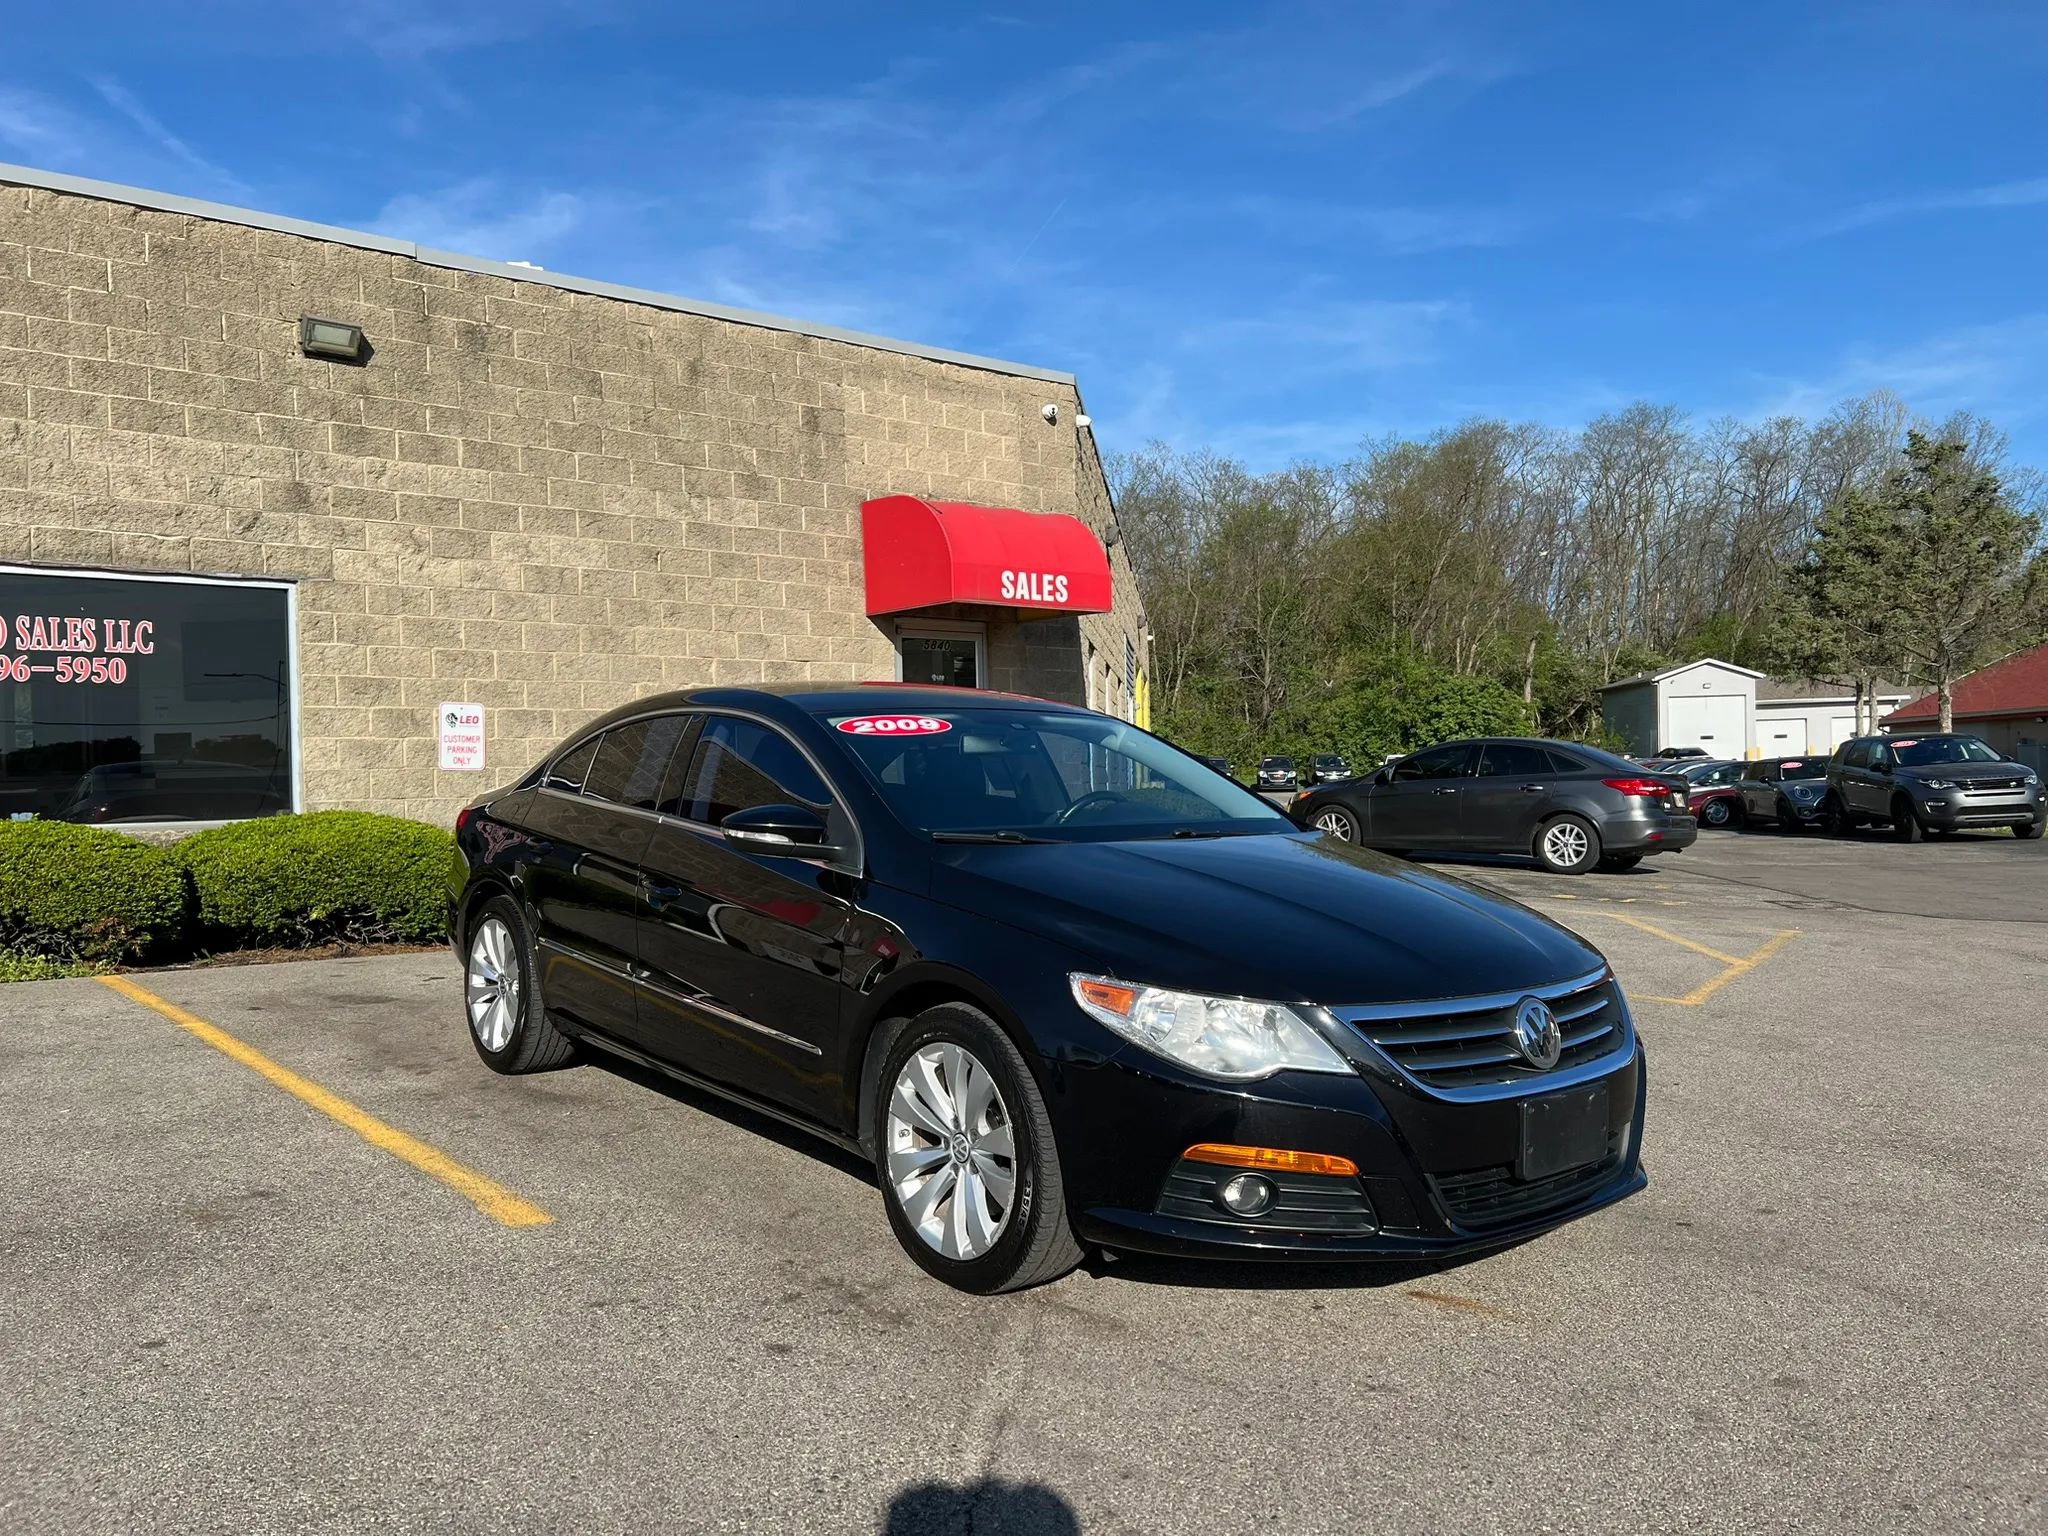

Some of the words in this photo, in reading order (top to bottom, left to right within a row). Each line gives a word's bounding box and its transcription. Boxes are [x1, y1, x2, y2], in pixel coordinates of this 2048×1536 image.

[1001, 570, 1068, 603] SALES
[16, 615, 97, 653] SALES
[104, 618, 154, 655] LLC
[923, 639, 951, 651] 5840
[459, 715, 479, 725] LEO
[852, 719, 941, 733] 2009
[443, 735, 480, 743] CUSTOMER
[447, 745, 478, 754] PARKING
[453, 756, 471, 764] ONLY
